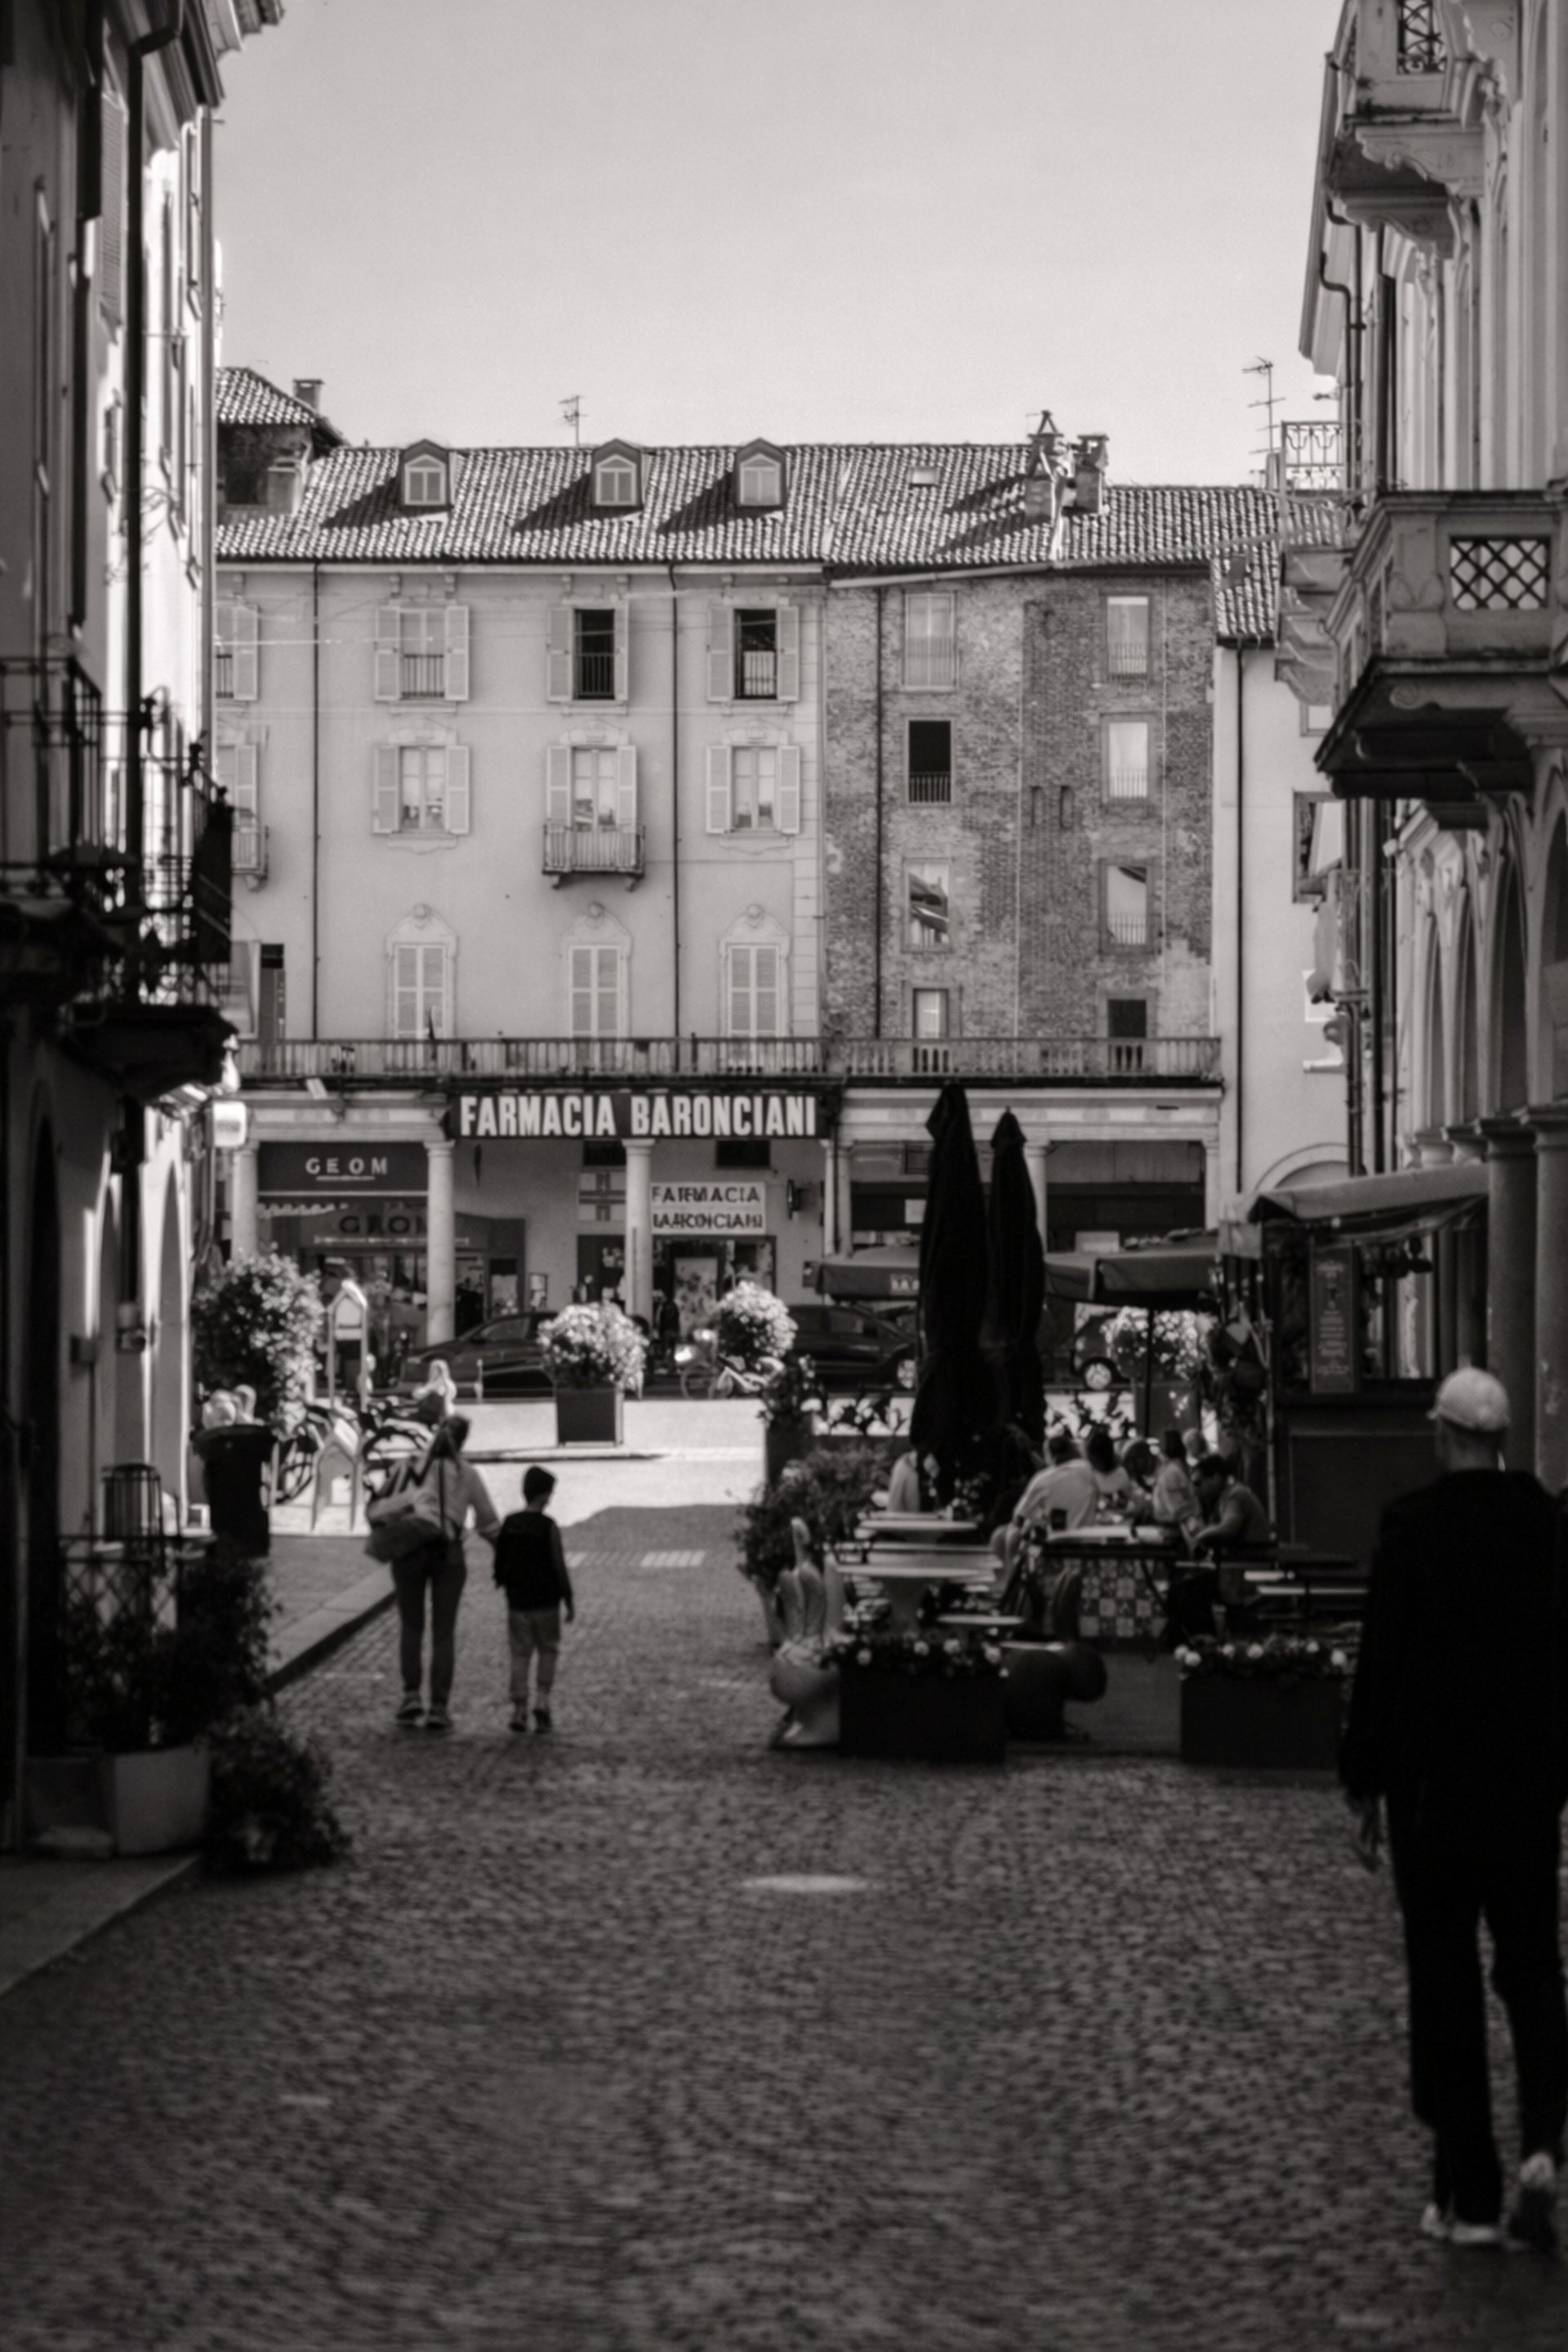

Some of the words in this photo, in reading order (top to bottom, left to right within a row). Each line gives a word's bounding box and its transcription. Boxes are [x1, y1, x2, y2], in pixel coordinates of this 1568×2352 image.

[460, 1095, 617, 1136] FARMACIA
[630, 1095, 815, 1136] BARONCIANI
[305, 1156, 388, 1174] GEOM
